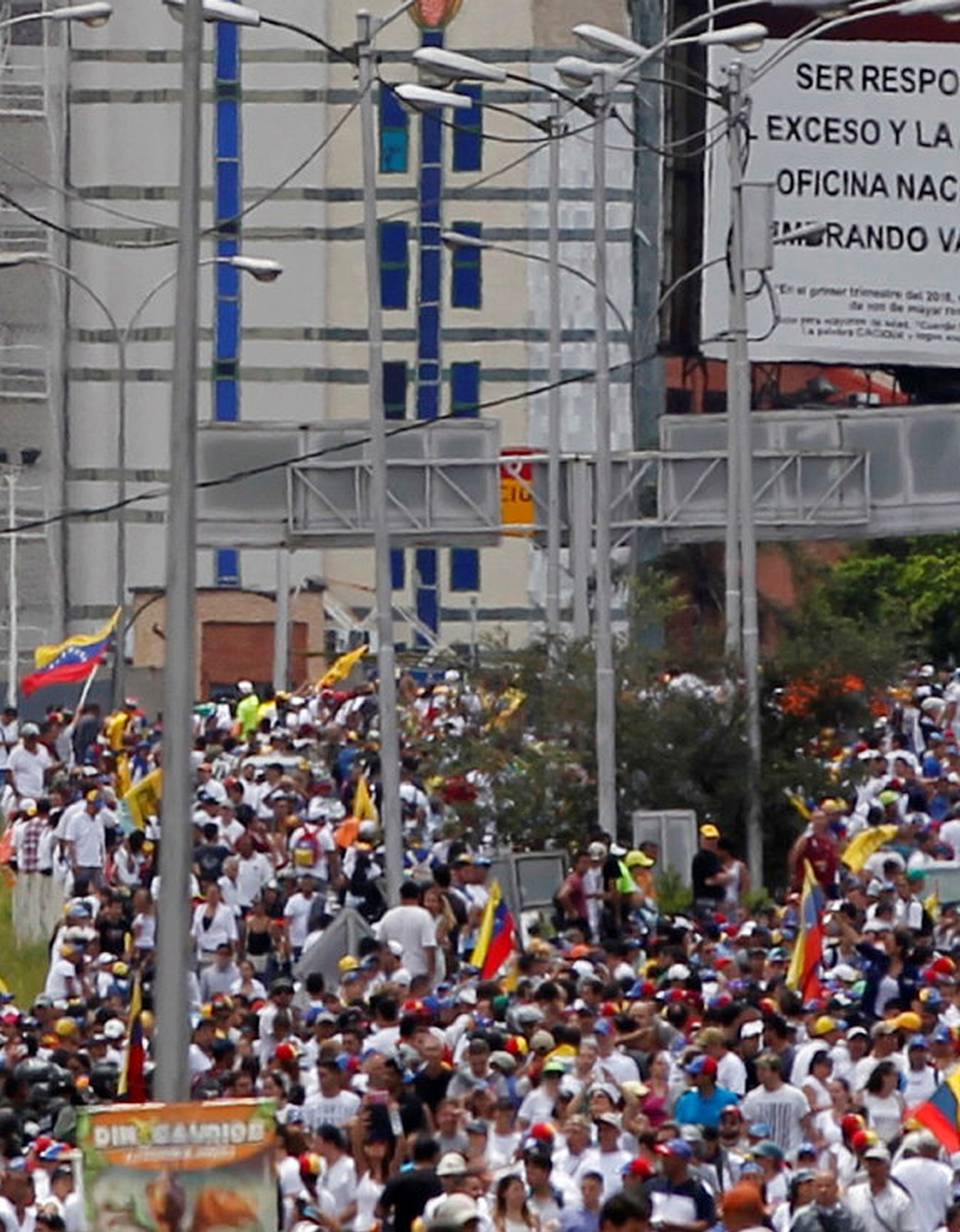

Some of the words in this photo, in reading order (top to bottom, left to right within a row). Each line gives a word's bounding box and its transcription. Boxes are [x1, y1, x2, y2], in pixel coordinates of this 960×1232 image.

[797, 63, 854, 91] SER
[767, 115, 880, 145] EXCESO
[889, 120, 906, 146] Y
[916, 121, 953, 148] LA
[776, 168, 889, 198] OFICINA
